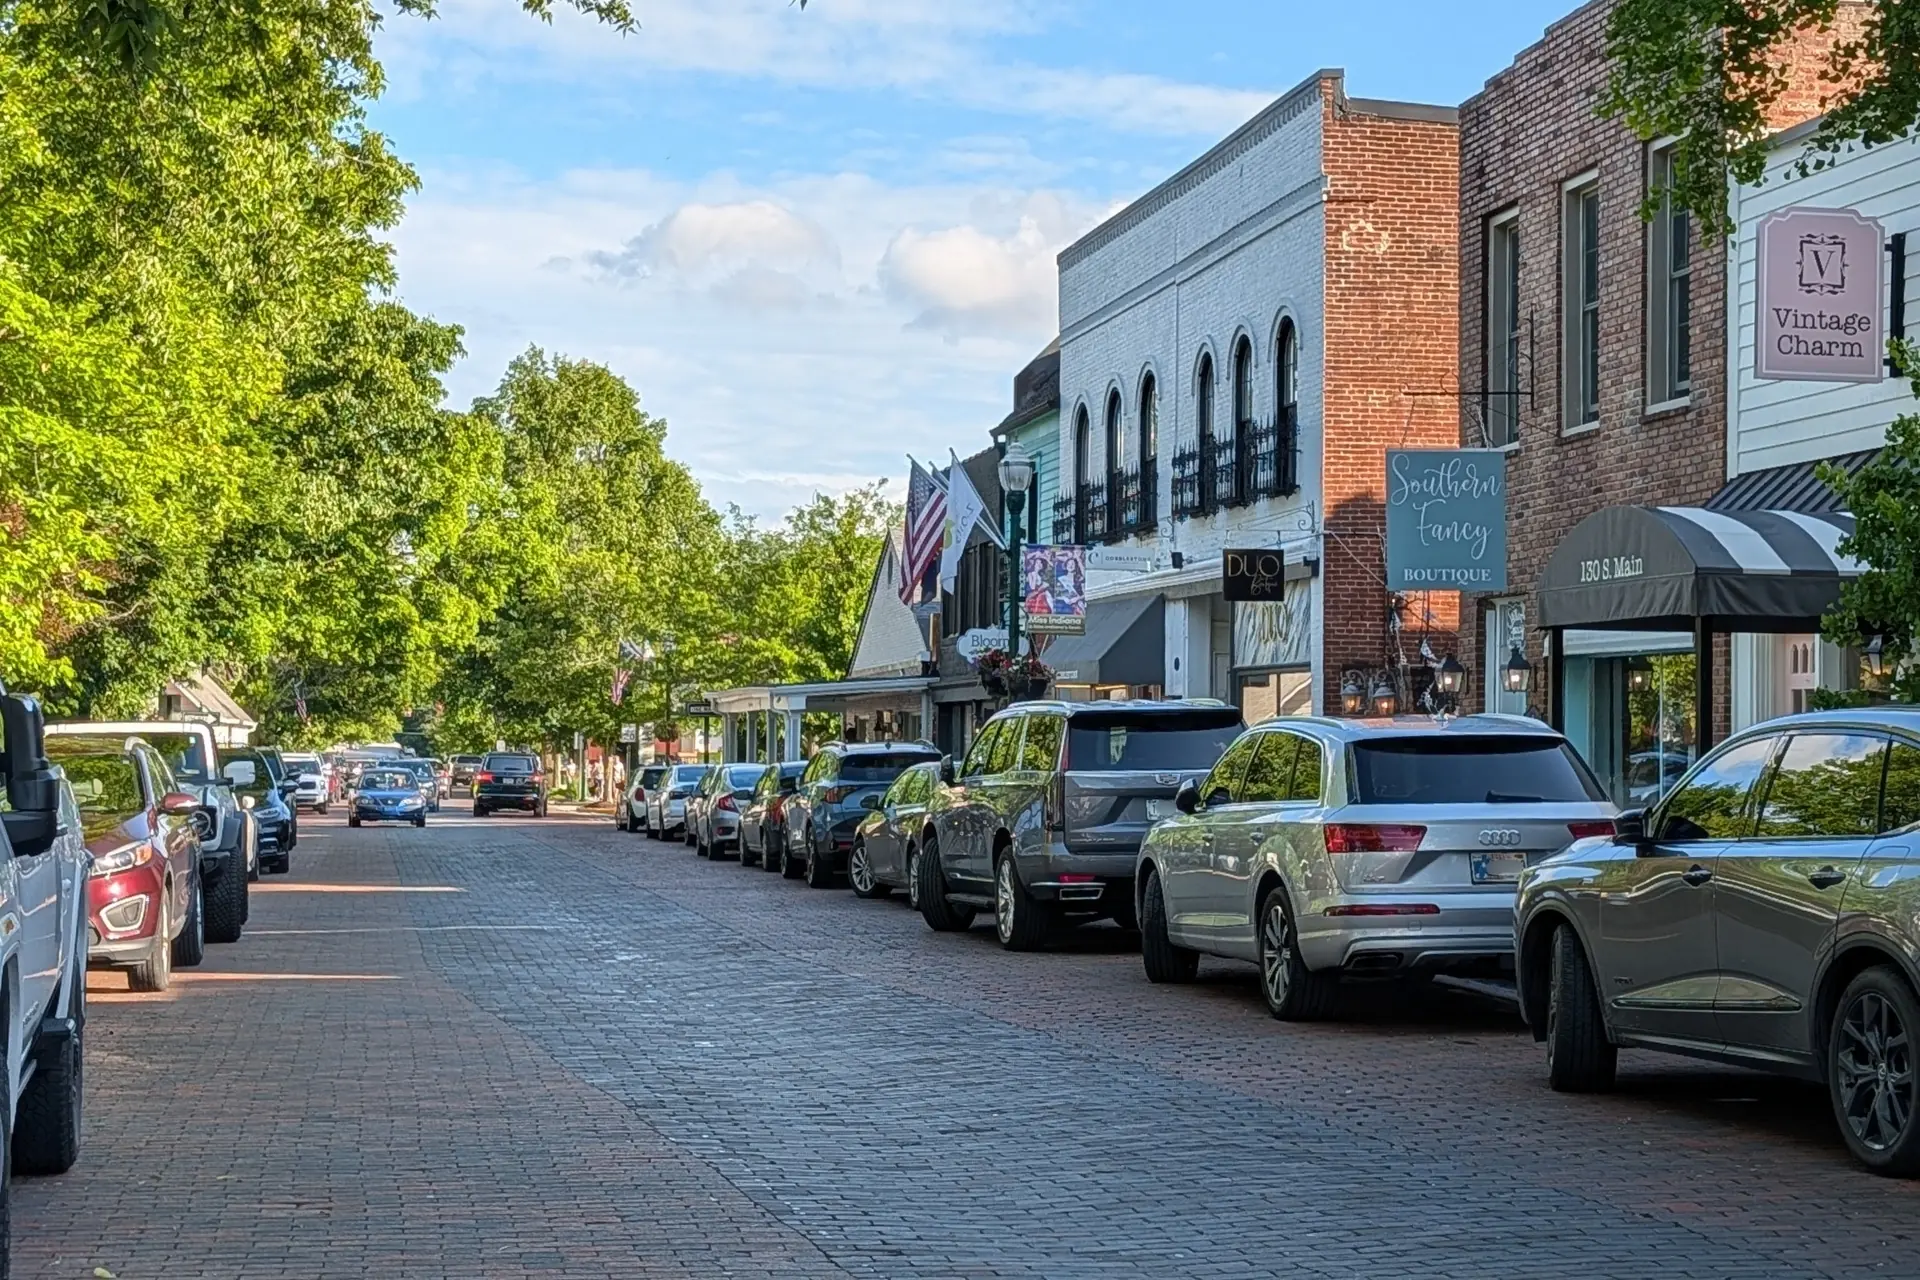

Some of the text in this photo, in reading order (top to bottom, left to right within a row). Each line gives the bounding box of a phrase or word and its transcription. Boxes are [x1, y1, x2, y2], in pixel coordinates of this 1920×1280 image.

[1810, 249, 1836, 279] V
[1772, 307, 1872, 336] Vintage
[1777, 333, 1865, 358] Charm
[1391, 453, 1502, 506] Southern
[1412, 498, 1493, 561] Fancy
[1227, 553, 1280, 578] DUO
[1403, 568, 1492, 586] BOUTIQUE
[1580, 555, 1643, 583] 130 S. Main
